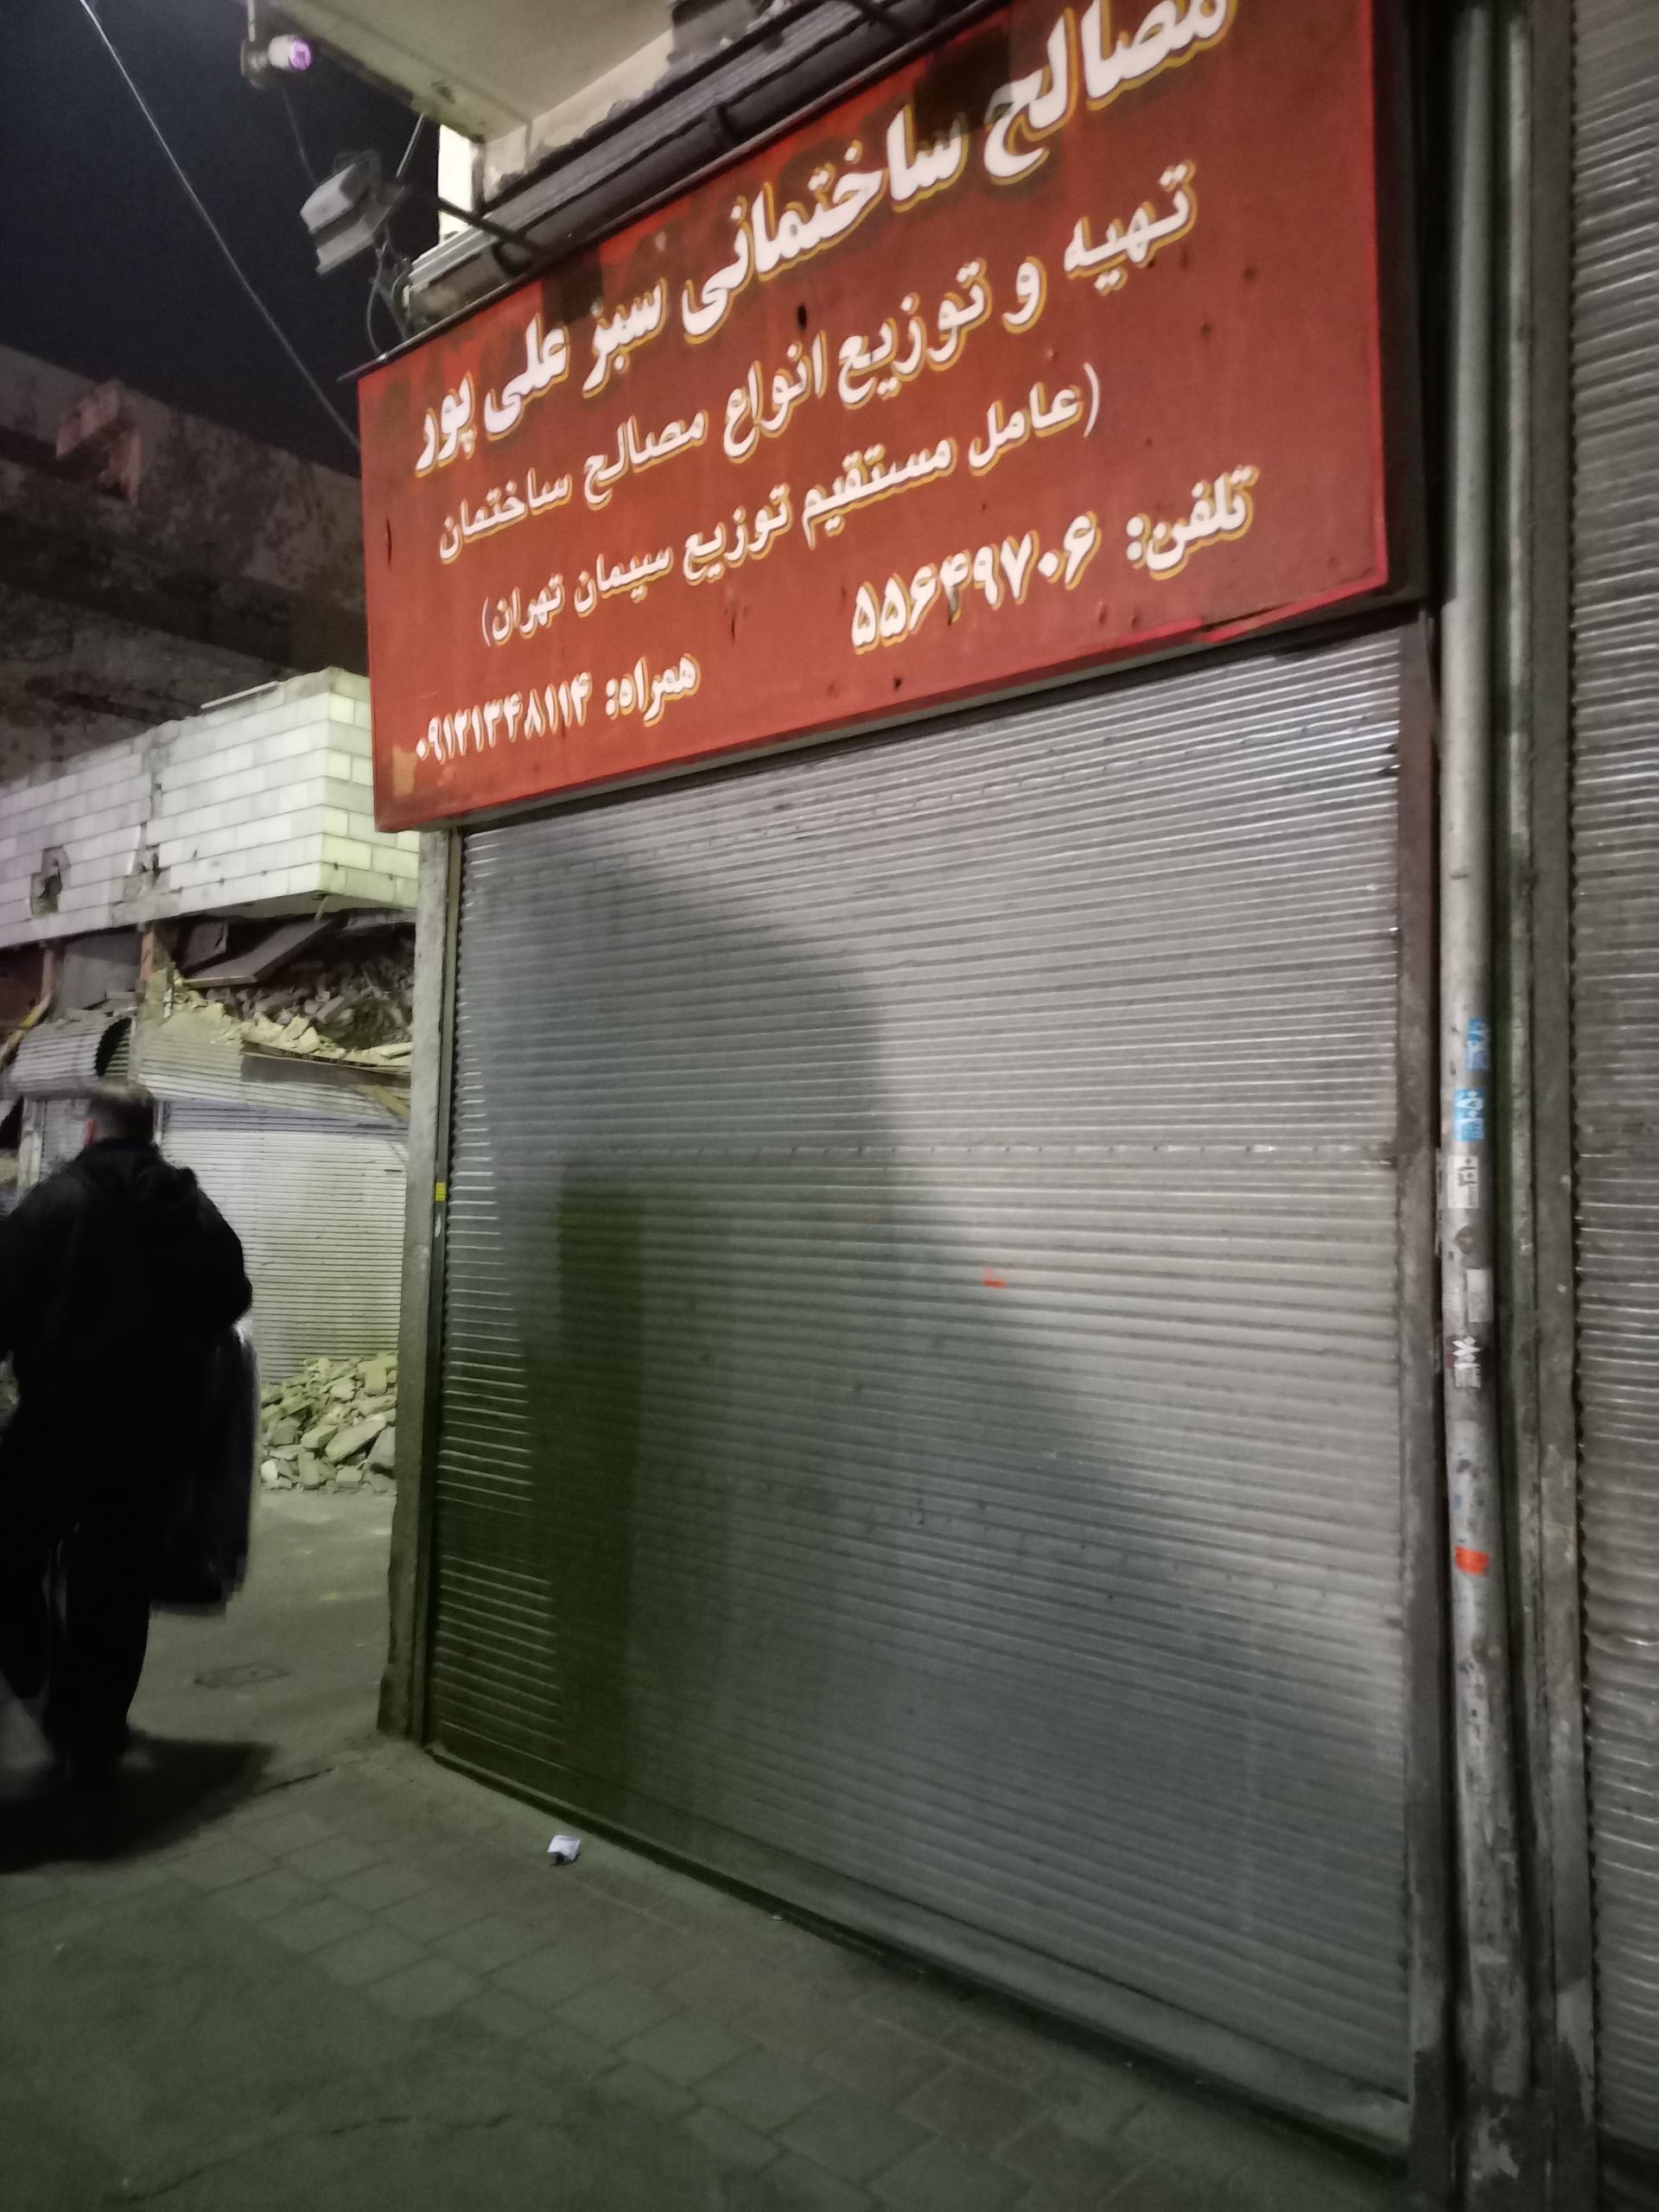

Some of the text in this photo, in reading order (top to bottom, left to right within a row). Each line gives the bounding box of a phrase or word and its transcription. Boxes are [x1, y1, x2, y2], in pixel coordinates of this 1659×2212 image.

[415, 0, 1236, 480] مصالح ساختمانی سبز علی پور
[437, 159, 1198, 565] تهیه و توزیع انواع مصالح ساختمان
[479, 361, 1103, 648] (عامل مستقیم توزیع سیمان تهران)
[850, 463, 1262, 655] تلفن: ۵۵۶۴۹۷۰۶
[415, 650, 702, 766] همراه: ۰۹۱۲۱۳۴۸۱۱۴
